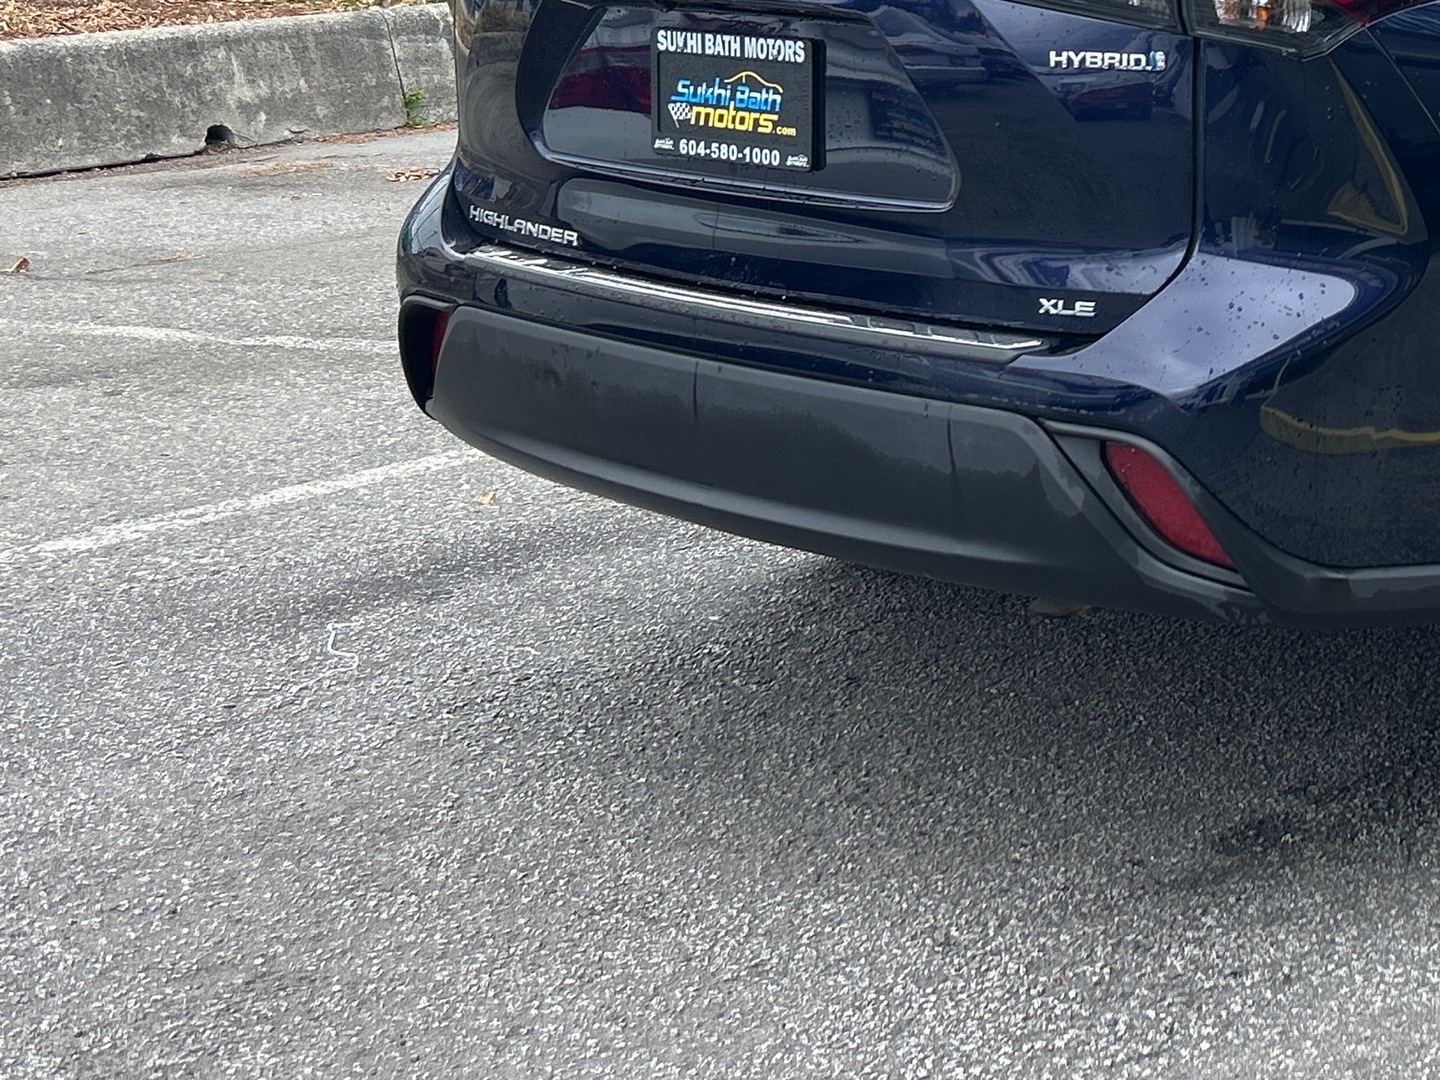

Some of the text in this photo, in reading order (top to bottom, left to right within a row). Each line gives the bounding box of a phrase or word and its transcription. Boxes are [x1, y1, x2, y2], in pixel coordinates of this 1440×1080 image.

[656, 29, 805, 63] SUKHI BATH MOTORS
[1049, 51, 1147, 70] HYBRID
[670, 77, 782, 112] Sukhi Bath
[679, 138, 780, 166] 604-580-1000
[469, 205, 578, 246] HIGHLANDER
[1038, 298, 1097, 318] XLE
